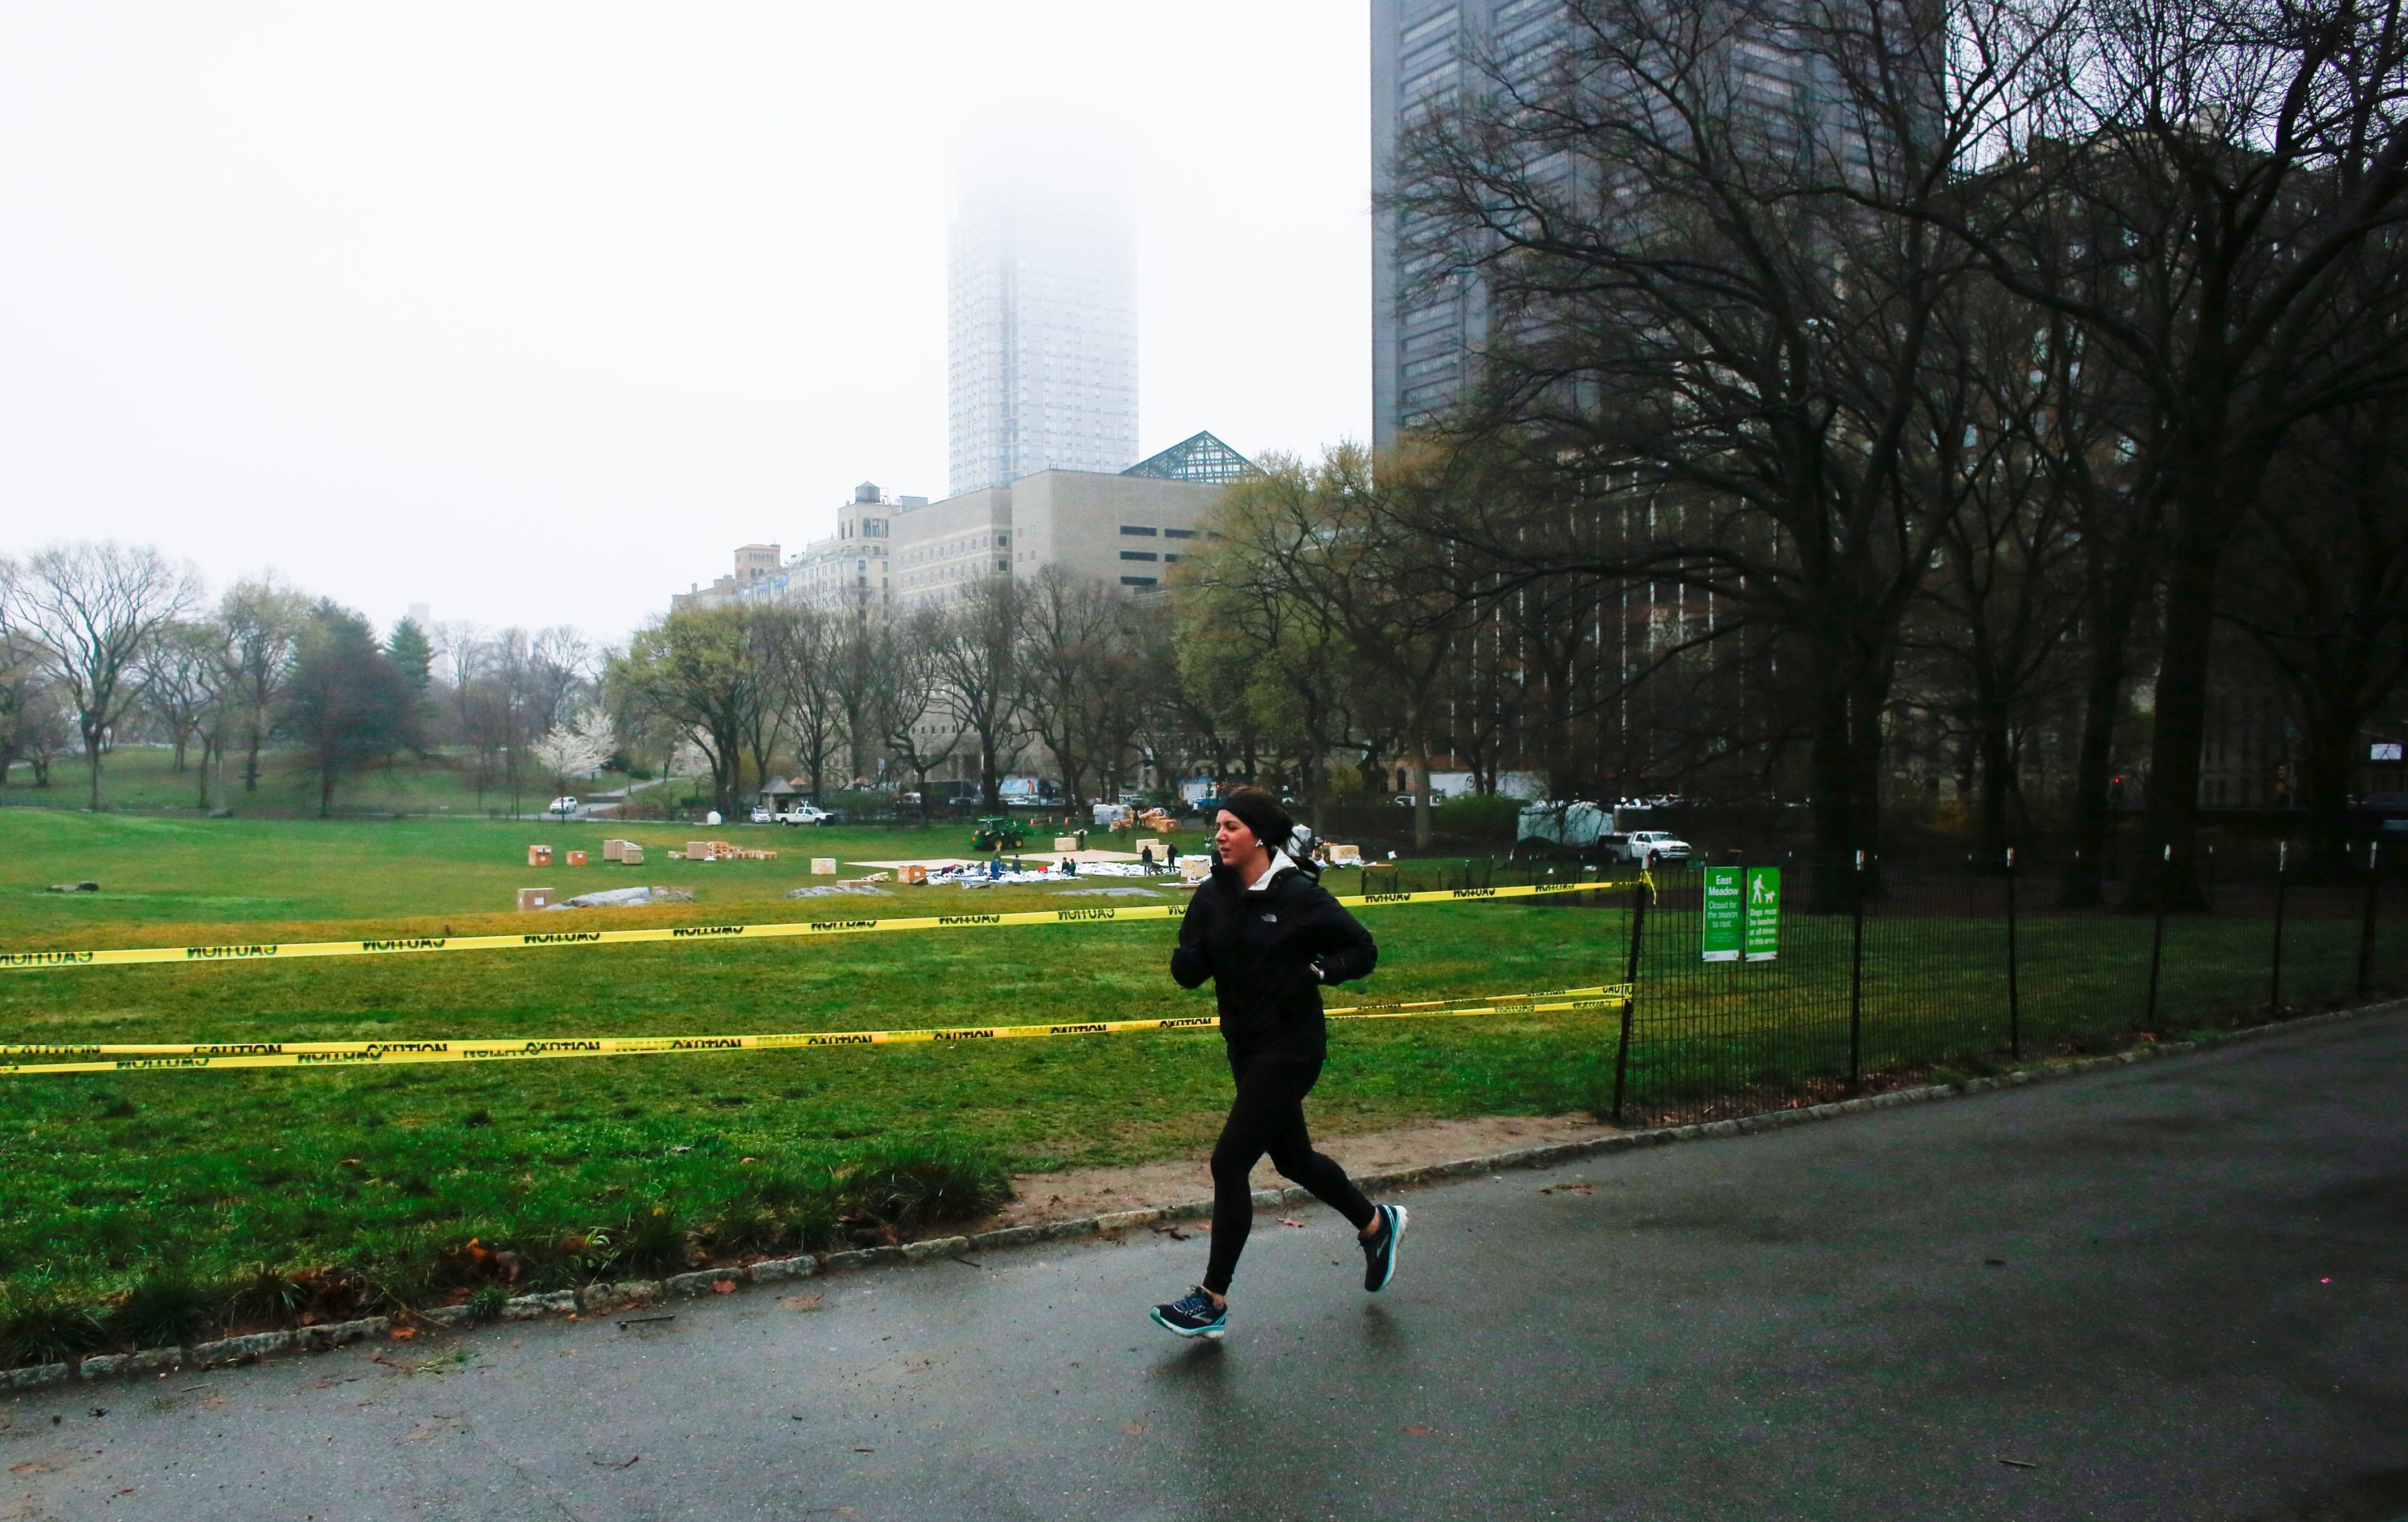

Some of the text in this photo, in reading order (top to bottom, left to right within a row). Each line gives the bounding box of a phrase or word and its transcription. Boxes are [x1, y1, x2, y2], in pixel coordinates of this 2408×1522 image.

[1716, 875, 1732, 885] East
[1708, 886, 1739, 896] Meadow
[1709, 900, 1737, 909] Closed for
[1708, 910, 1717, 918] the
[1750, 908, 1763, 917] Dogs
